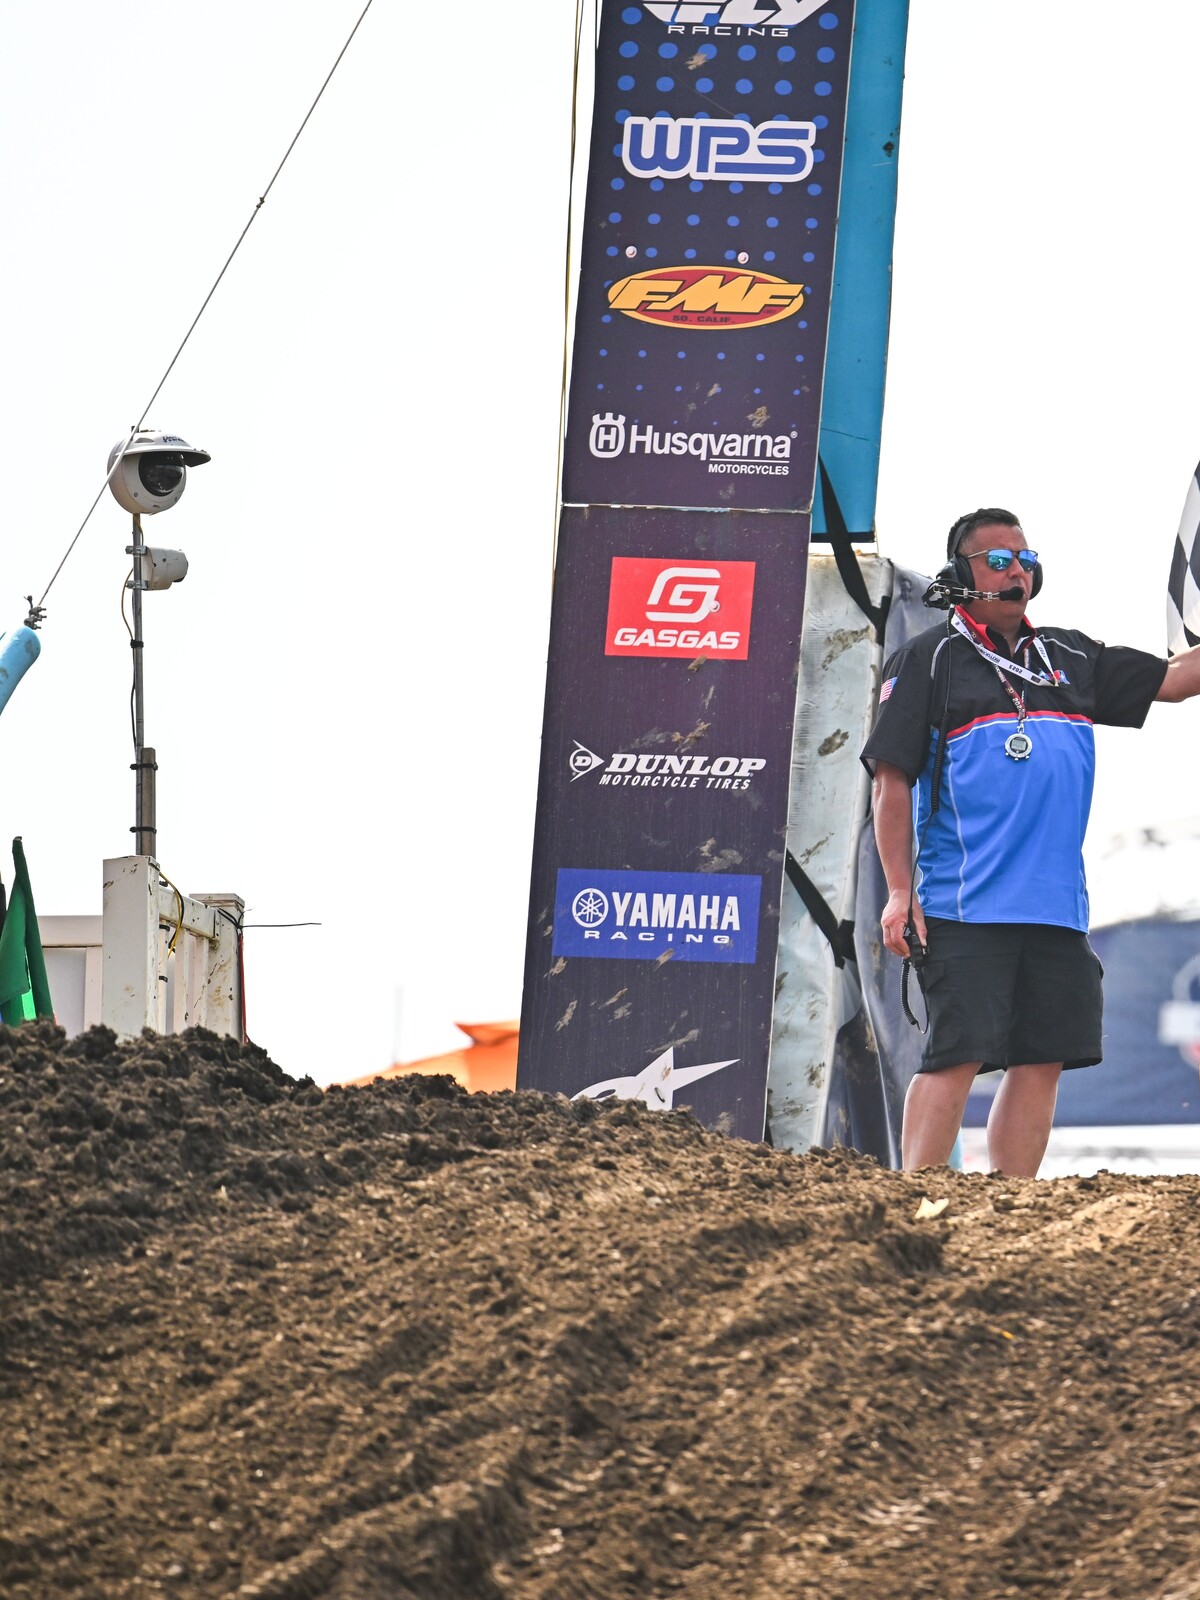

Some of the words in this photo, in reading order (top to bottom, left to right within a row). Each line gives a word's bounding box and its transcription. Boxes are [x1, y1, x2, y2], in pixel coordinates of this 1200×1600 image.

[667, 25, 789, 37] RACING
[624, 119, 815, 180] WPS
[608, 274, 805, 314] FMF
[629, 424, 791, 460] Husqvarna
[708, 463, 789, 476] MOTORCYCLES
[613, 627, 740, 650] GASGAS
[605, 753, 767, 776] DUNLOP
[599, 774, 699, 788] MOTORCYCLE
[705, 777, 751, 790] TIRES
[611, 891, 740, 931] YAMAHA
[584, 930, 730, 944] RACING
